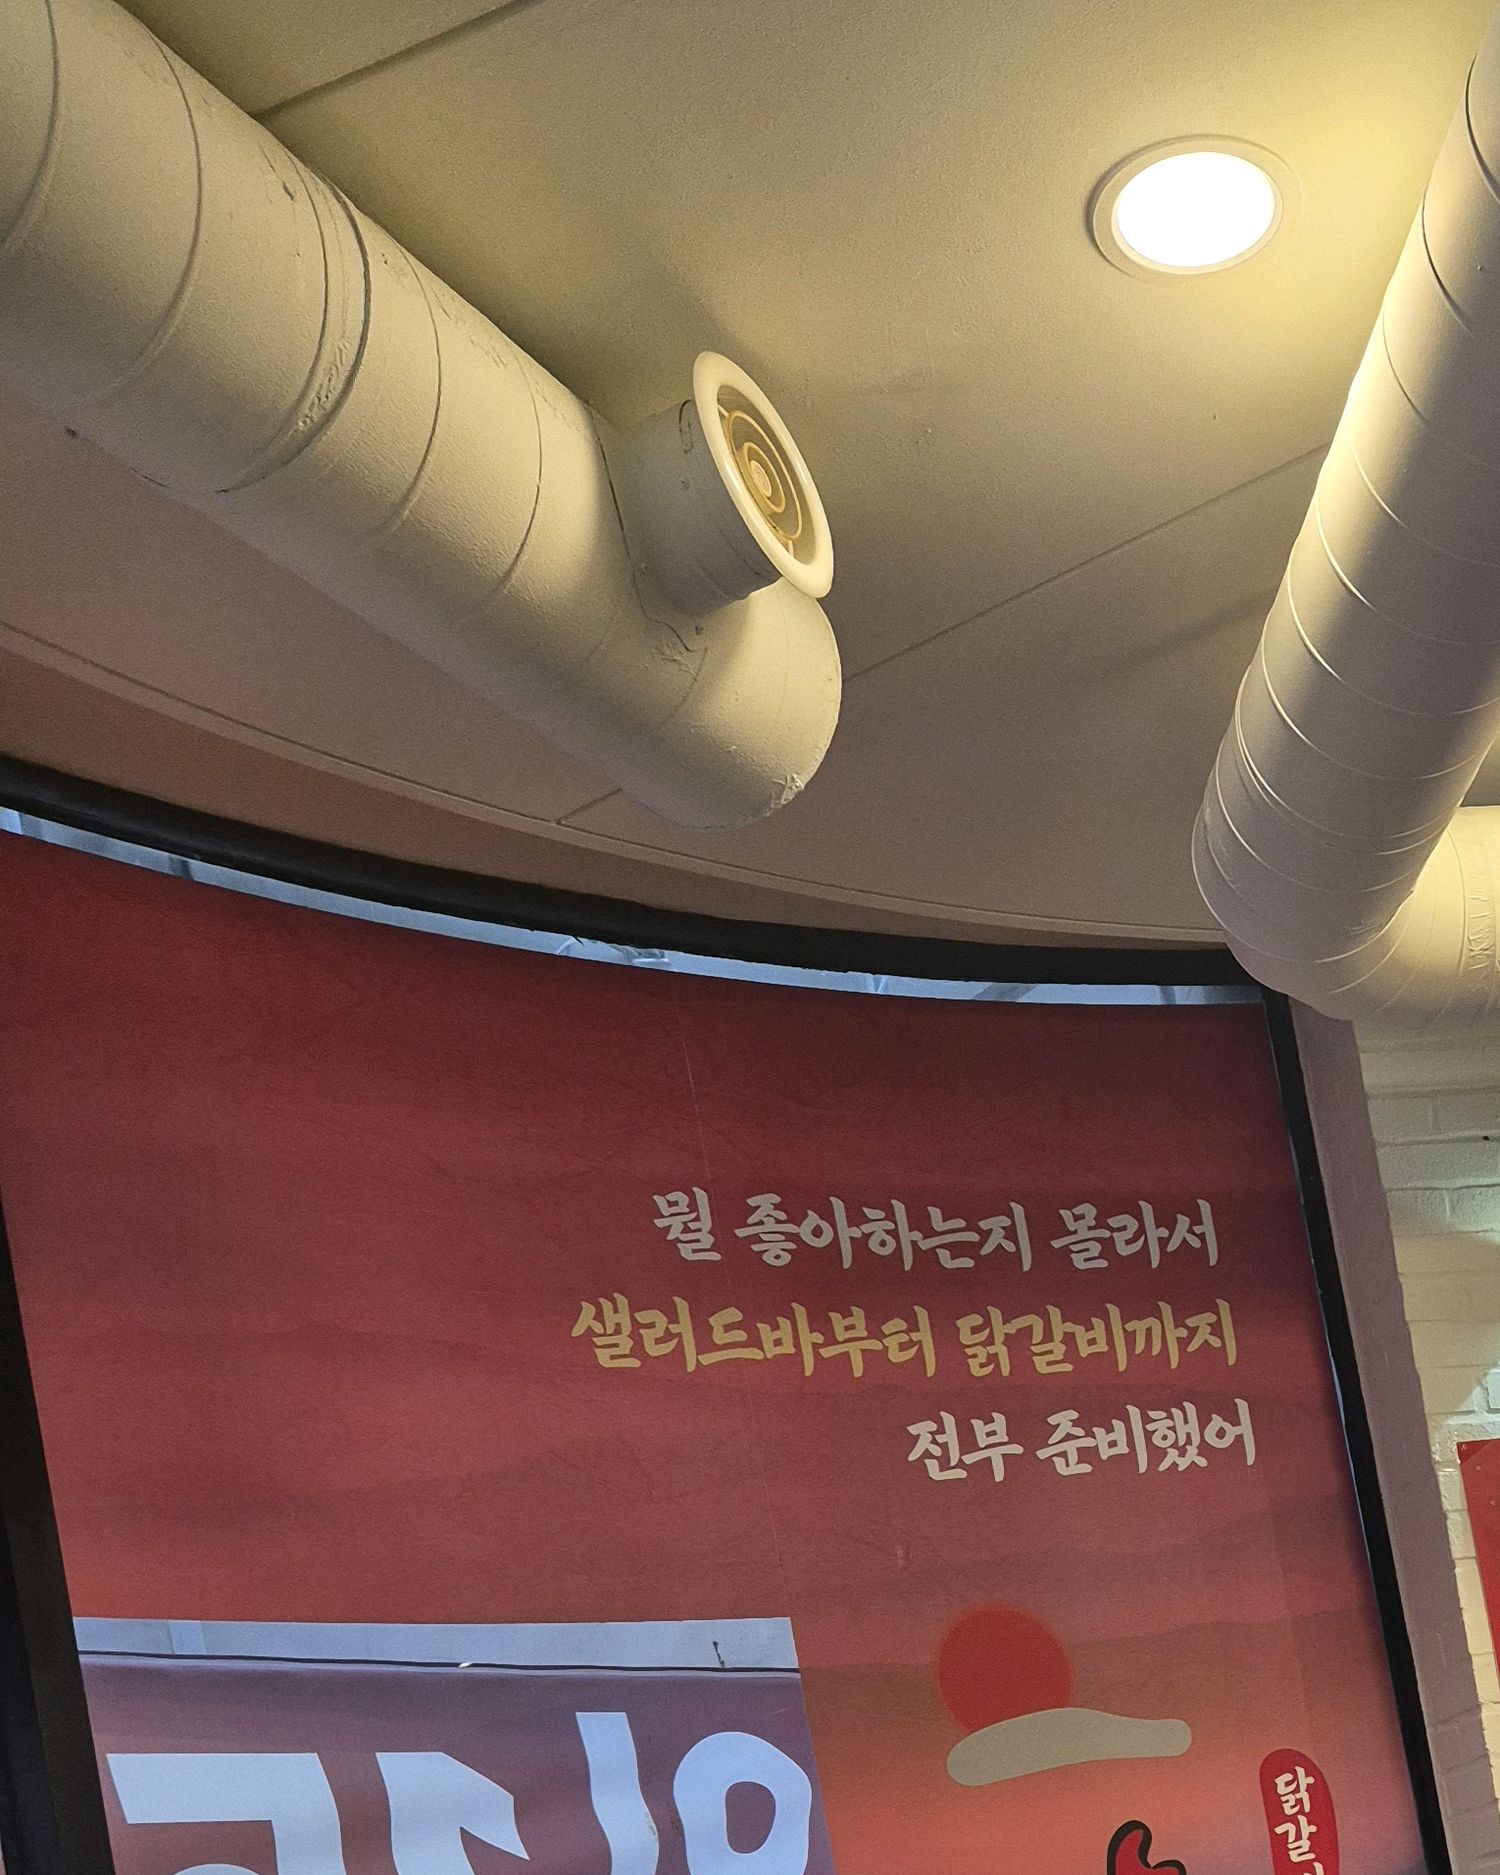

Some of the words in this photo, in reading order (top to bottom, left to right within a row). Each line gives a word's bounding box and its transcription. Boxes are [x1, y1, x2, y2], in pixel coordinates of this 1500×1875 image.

[653, 1186, 715, 1263] 뭘
[734, 1193, 1033, 1273] 좋아하는지
[1050, 1200, 1220, 1270] 몰라서
[571, 1291, 937, 1378] 샐러드바부터
[955, 1299, 1240, 1378] 닭갈비까지
[906, 1410, 1025, 1483] 전부
[1034, 1400, 1255, 1477] 준비했어
